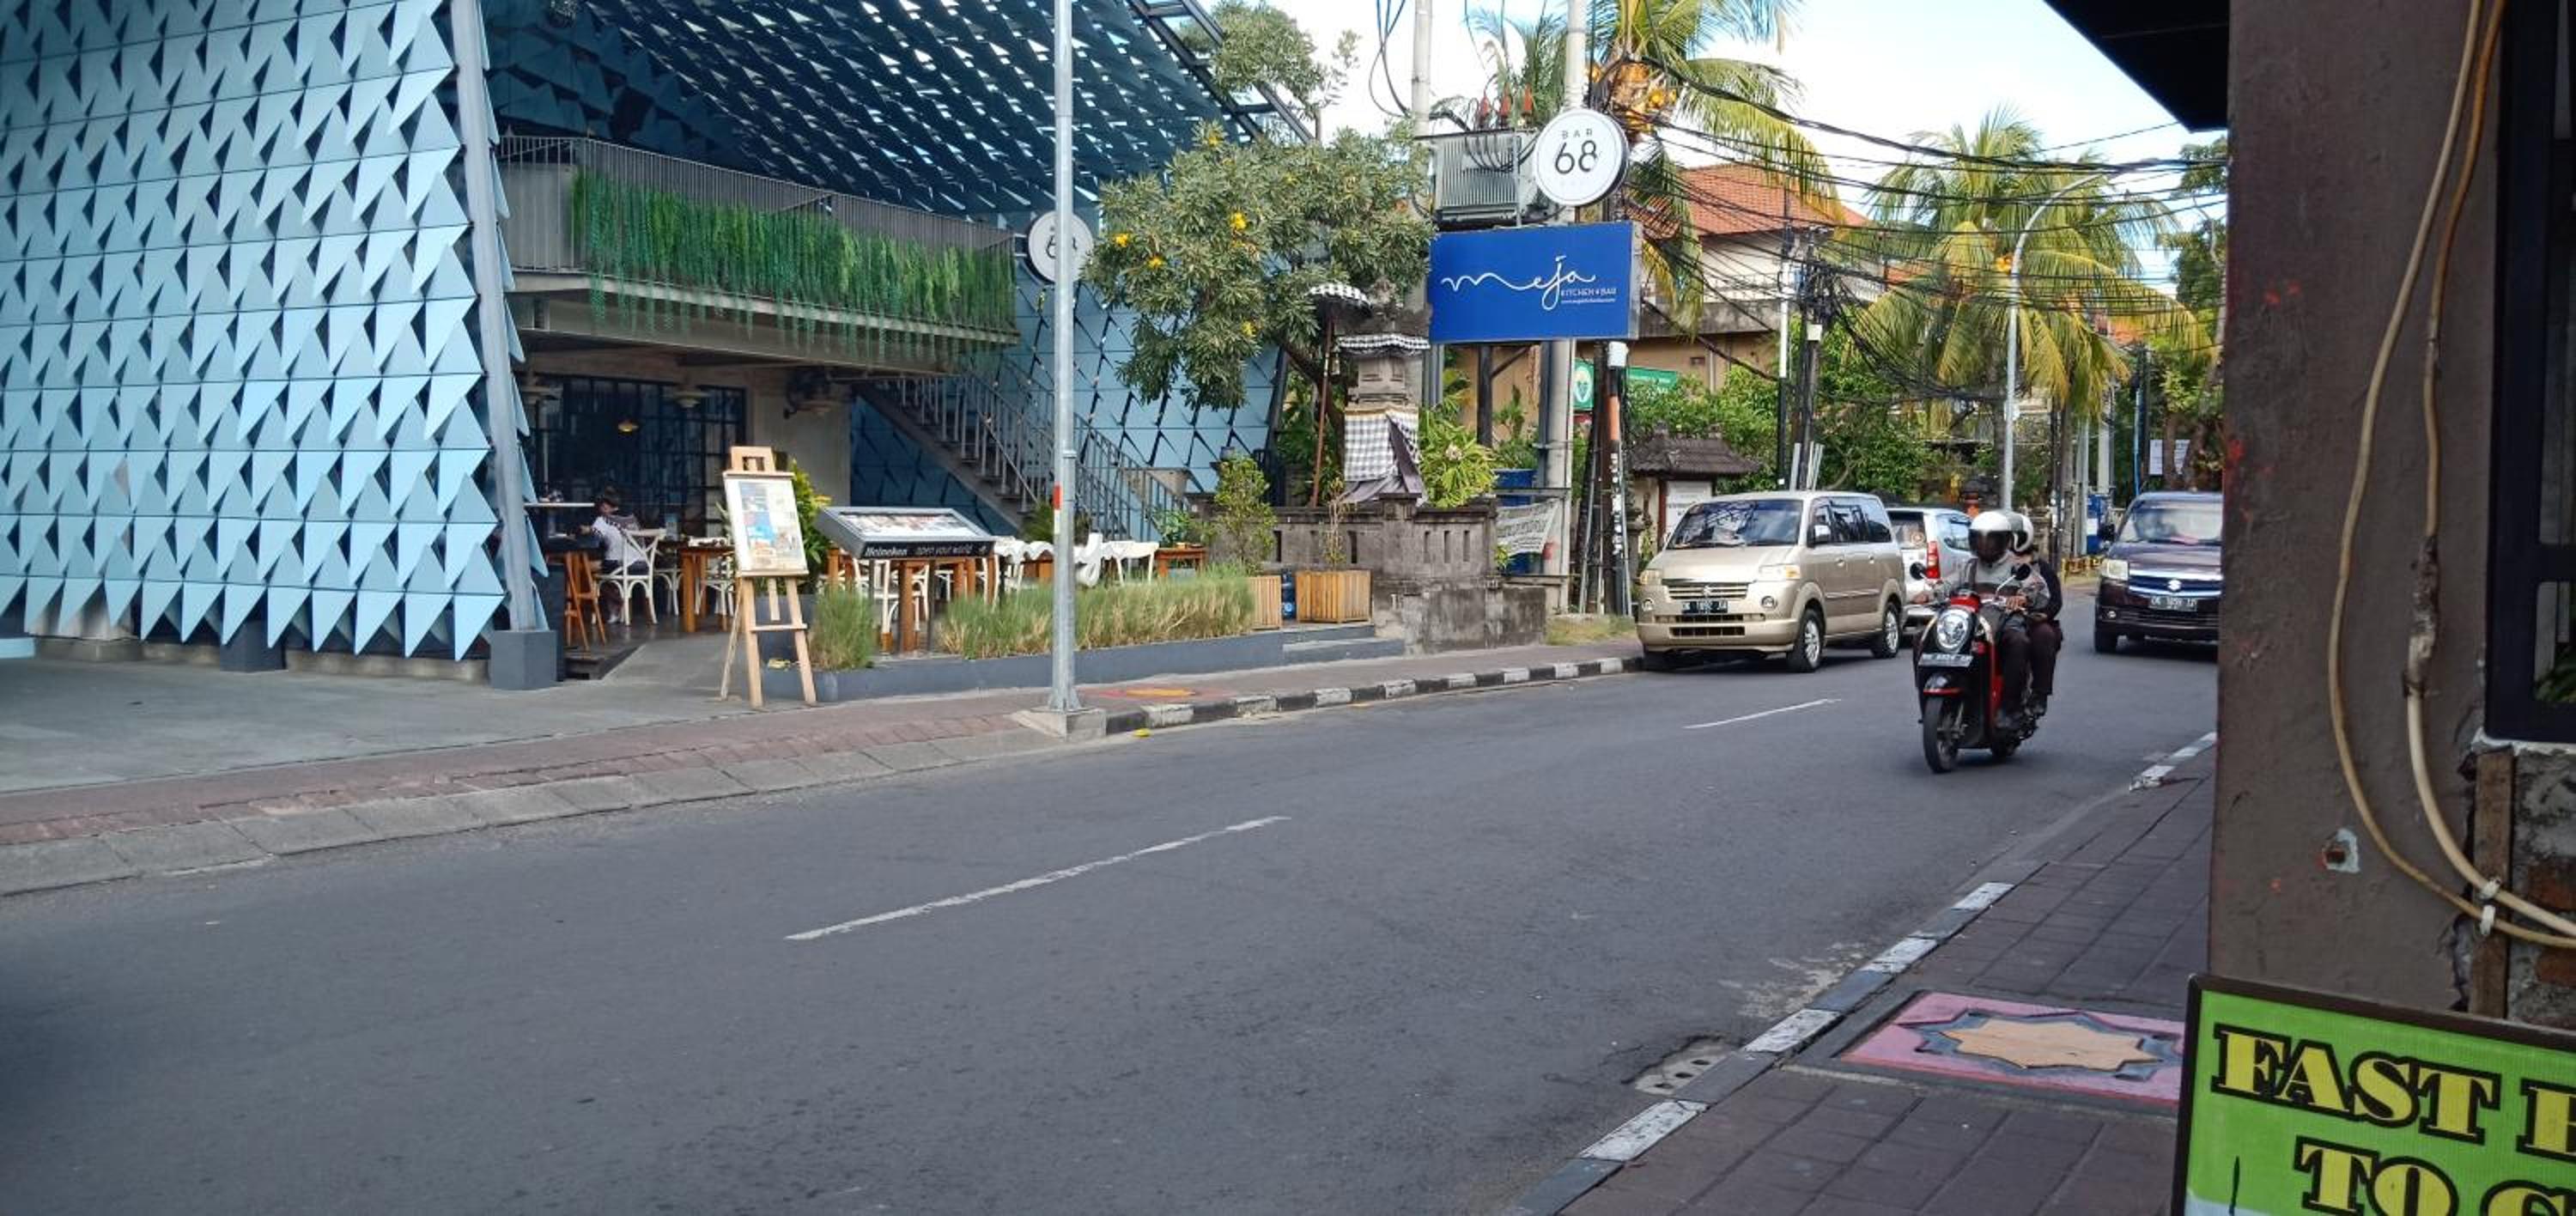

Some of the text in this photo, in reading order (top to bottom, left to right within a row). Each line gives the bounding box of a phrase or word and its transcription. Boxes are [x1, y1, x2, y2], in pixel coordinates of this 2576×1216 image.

[1561, 128, 1593, 139] BAR
[1555, 140, 1597, 174] 68
[1440, 255, 1596, 310] meja
[865, 546, 908, 556] Heineken
[2212, 1023, 2501, 1146] FAST
[2294, 1135, 2458, 1216] TO
